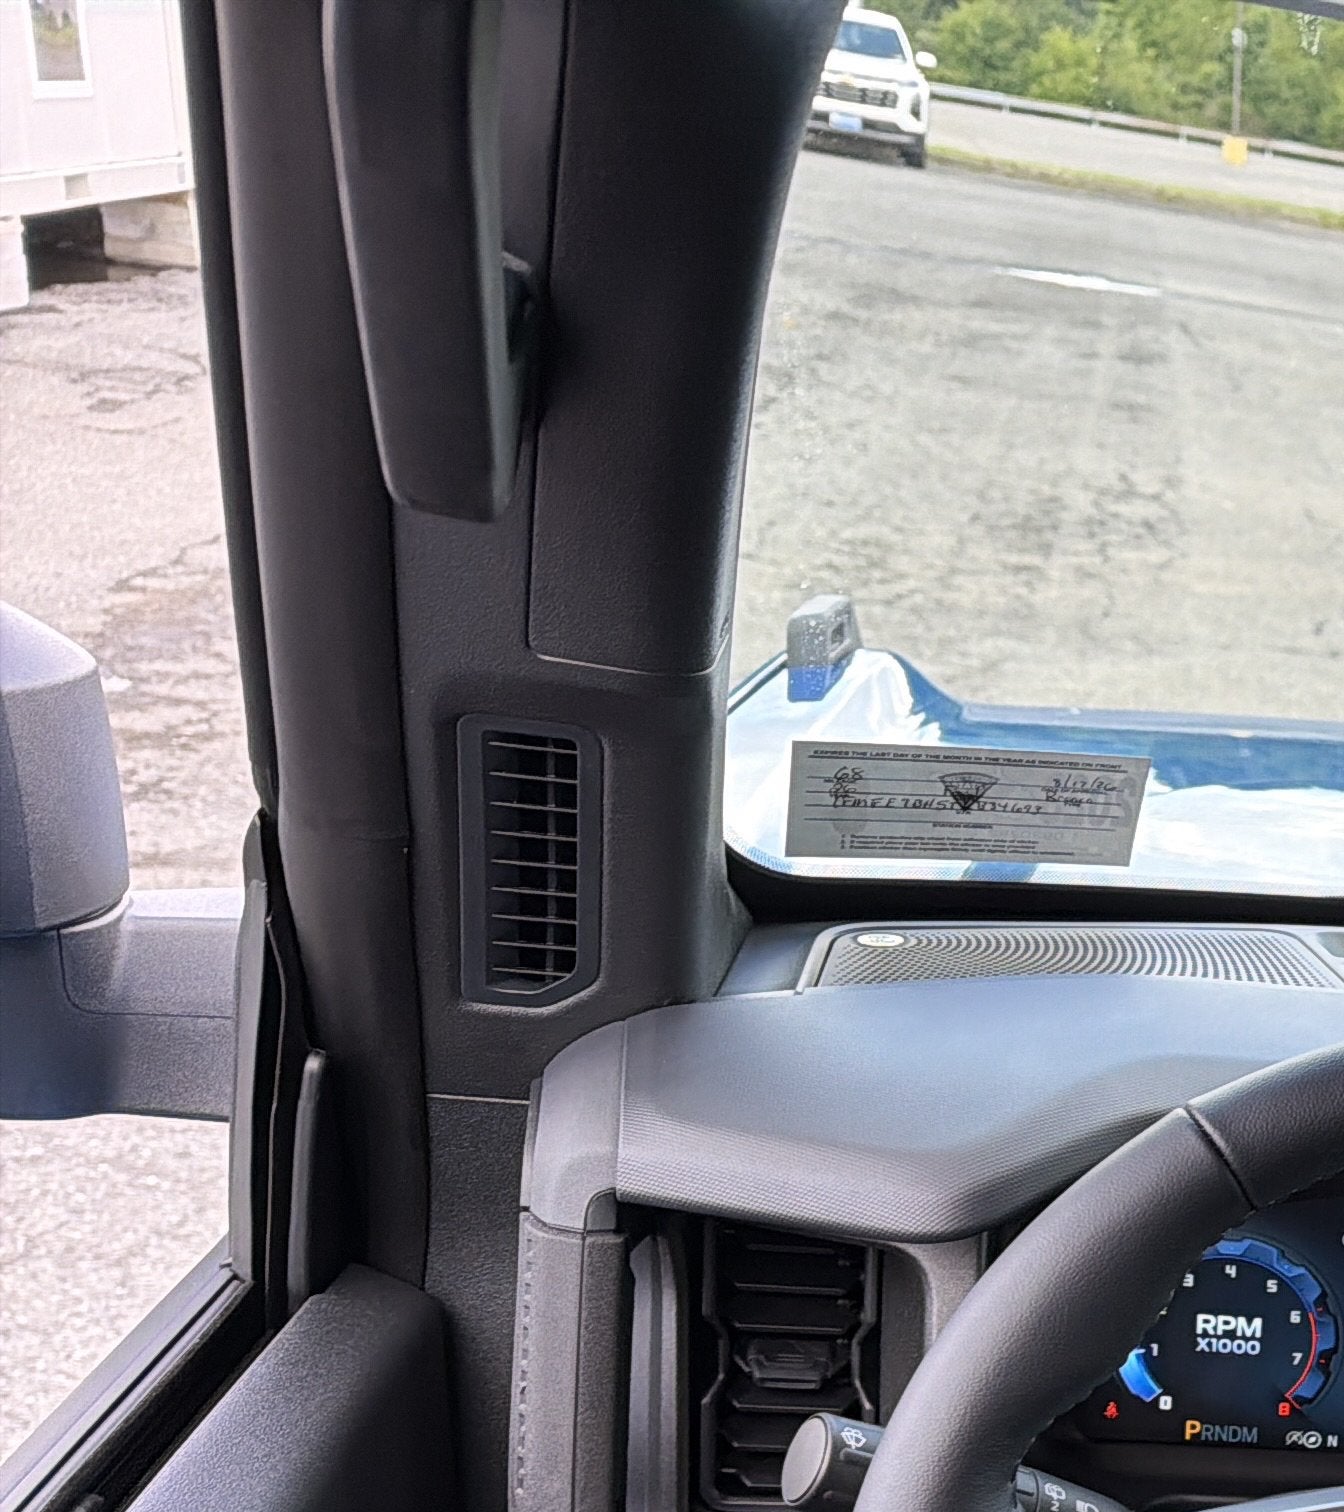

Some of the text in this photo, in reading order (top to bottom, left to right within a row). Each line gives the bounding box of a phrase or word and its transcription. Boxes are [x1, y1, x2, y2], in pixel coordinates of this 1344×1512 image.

[1225, 1265, 1237, 1279] 4
[1183, 1273, 1195, 1287] 3
[1266, 1279, 1278, 1293] 5
[1289, 1310, 1301, 1324] 6
[1195, 1313, 1263, 1338] RPM
[1150, 1343, 1159, 1357] 1
[1195, 1337, 1262, 1356] X1000
[1292, 1353, 1303, 1366] 7
[1159, 1395, 1173, 1410] 0
[1278, 1402, 1290, 1416] 8
